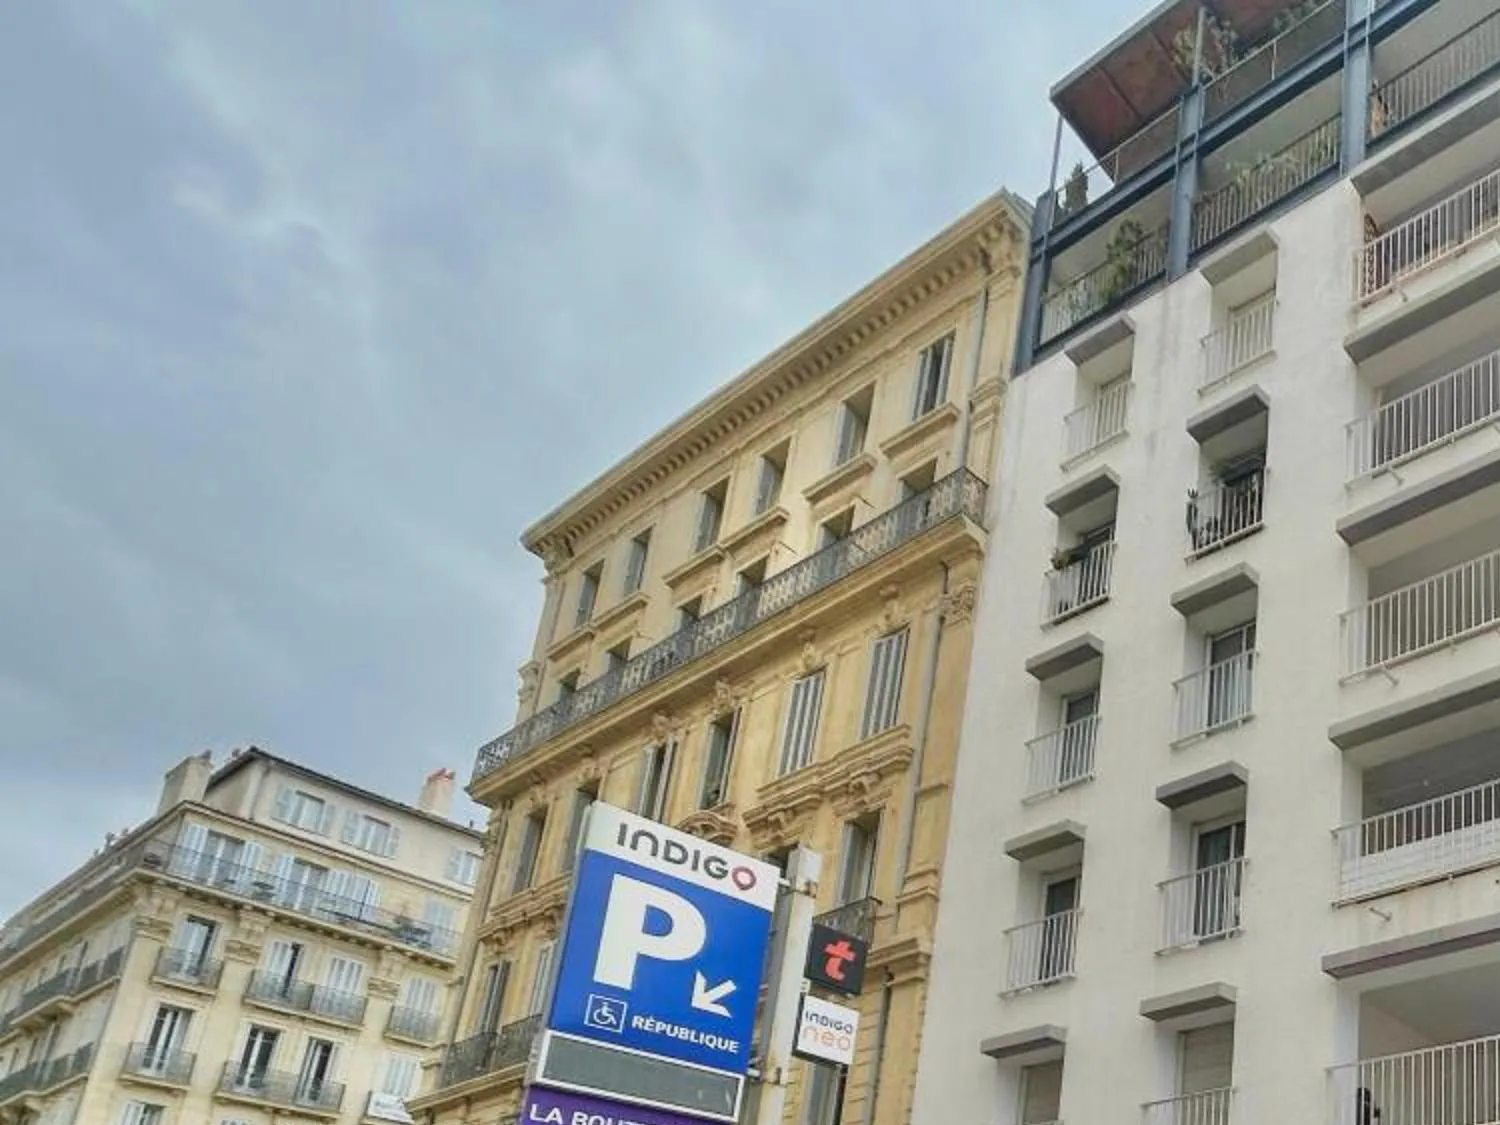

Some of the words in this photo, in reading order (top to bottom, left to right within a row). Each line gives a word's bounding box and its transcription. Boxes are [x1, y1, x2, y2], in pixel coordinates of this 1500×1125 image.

[617, 823, 757, 891] INDIGO
[594, 873, 706, 990] P
[631, 1015, 740, 1054] RÉPUBLIQUE
[803, 1026, 851, 1051] neo
[529, 1103, 563, 1125] LA
